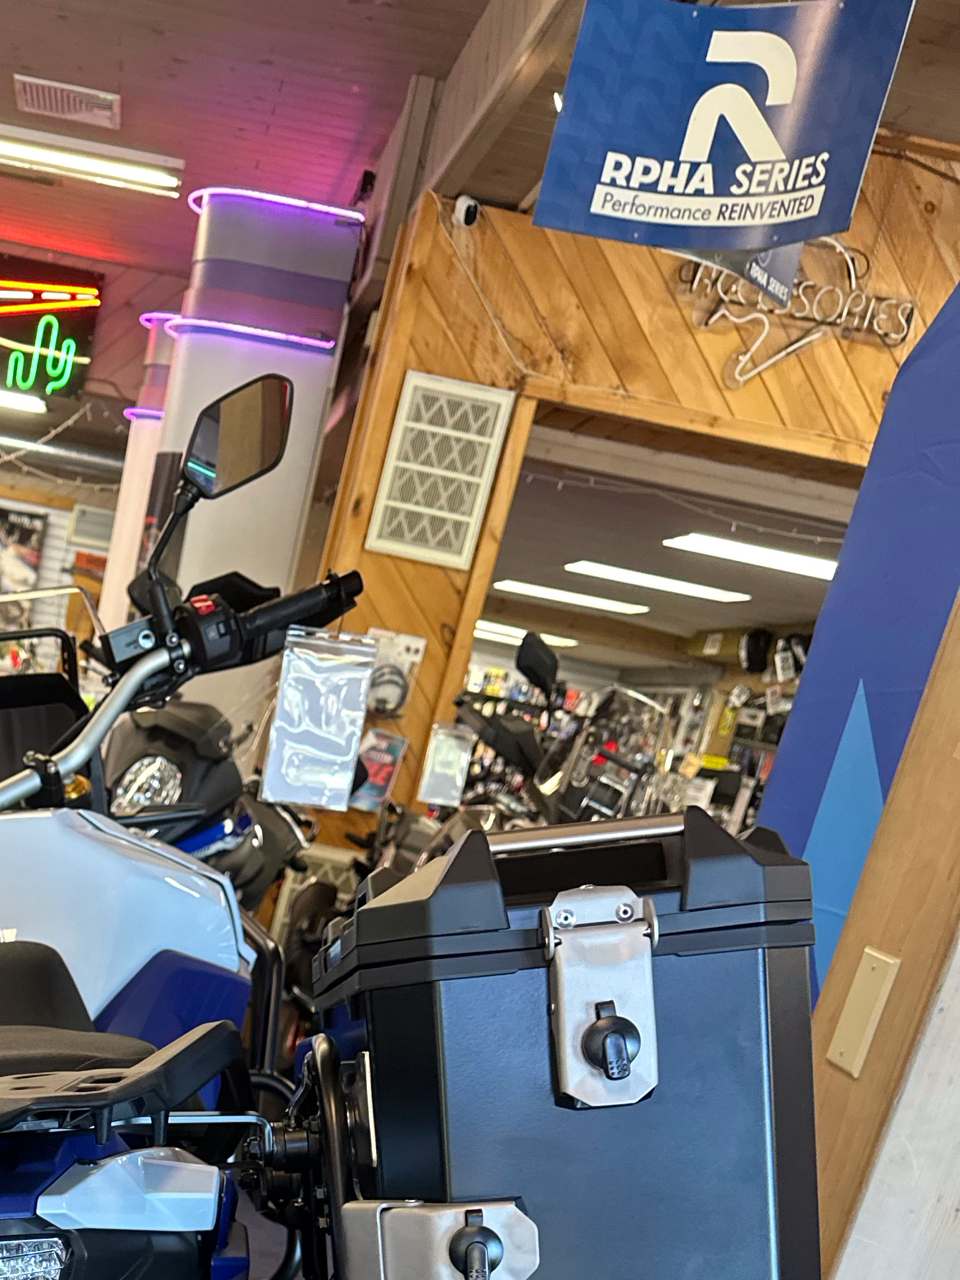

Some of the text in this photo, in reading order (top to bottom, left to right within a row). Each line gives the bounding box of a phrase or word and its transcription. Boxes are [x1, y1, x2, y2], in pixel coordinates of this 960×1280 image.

[600, 150, 830, 196] RPHA SERIES
[600, 191, 815, 222] Performance REINVENTED
[768, 276, 789, 302] SERIES
